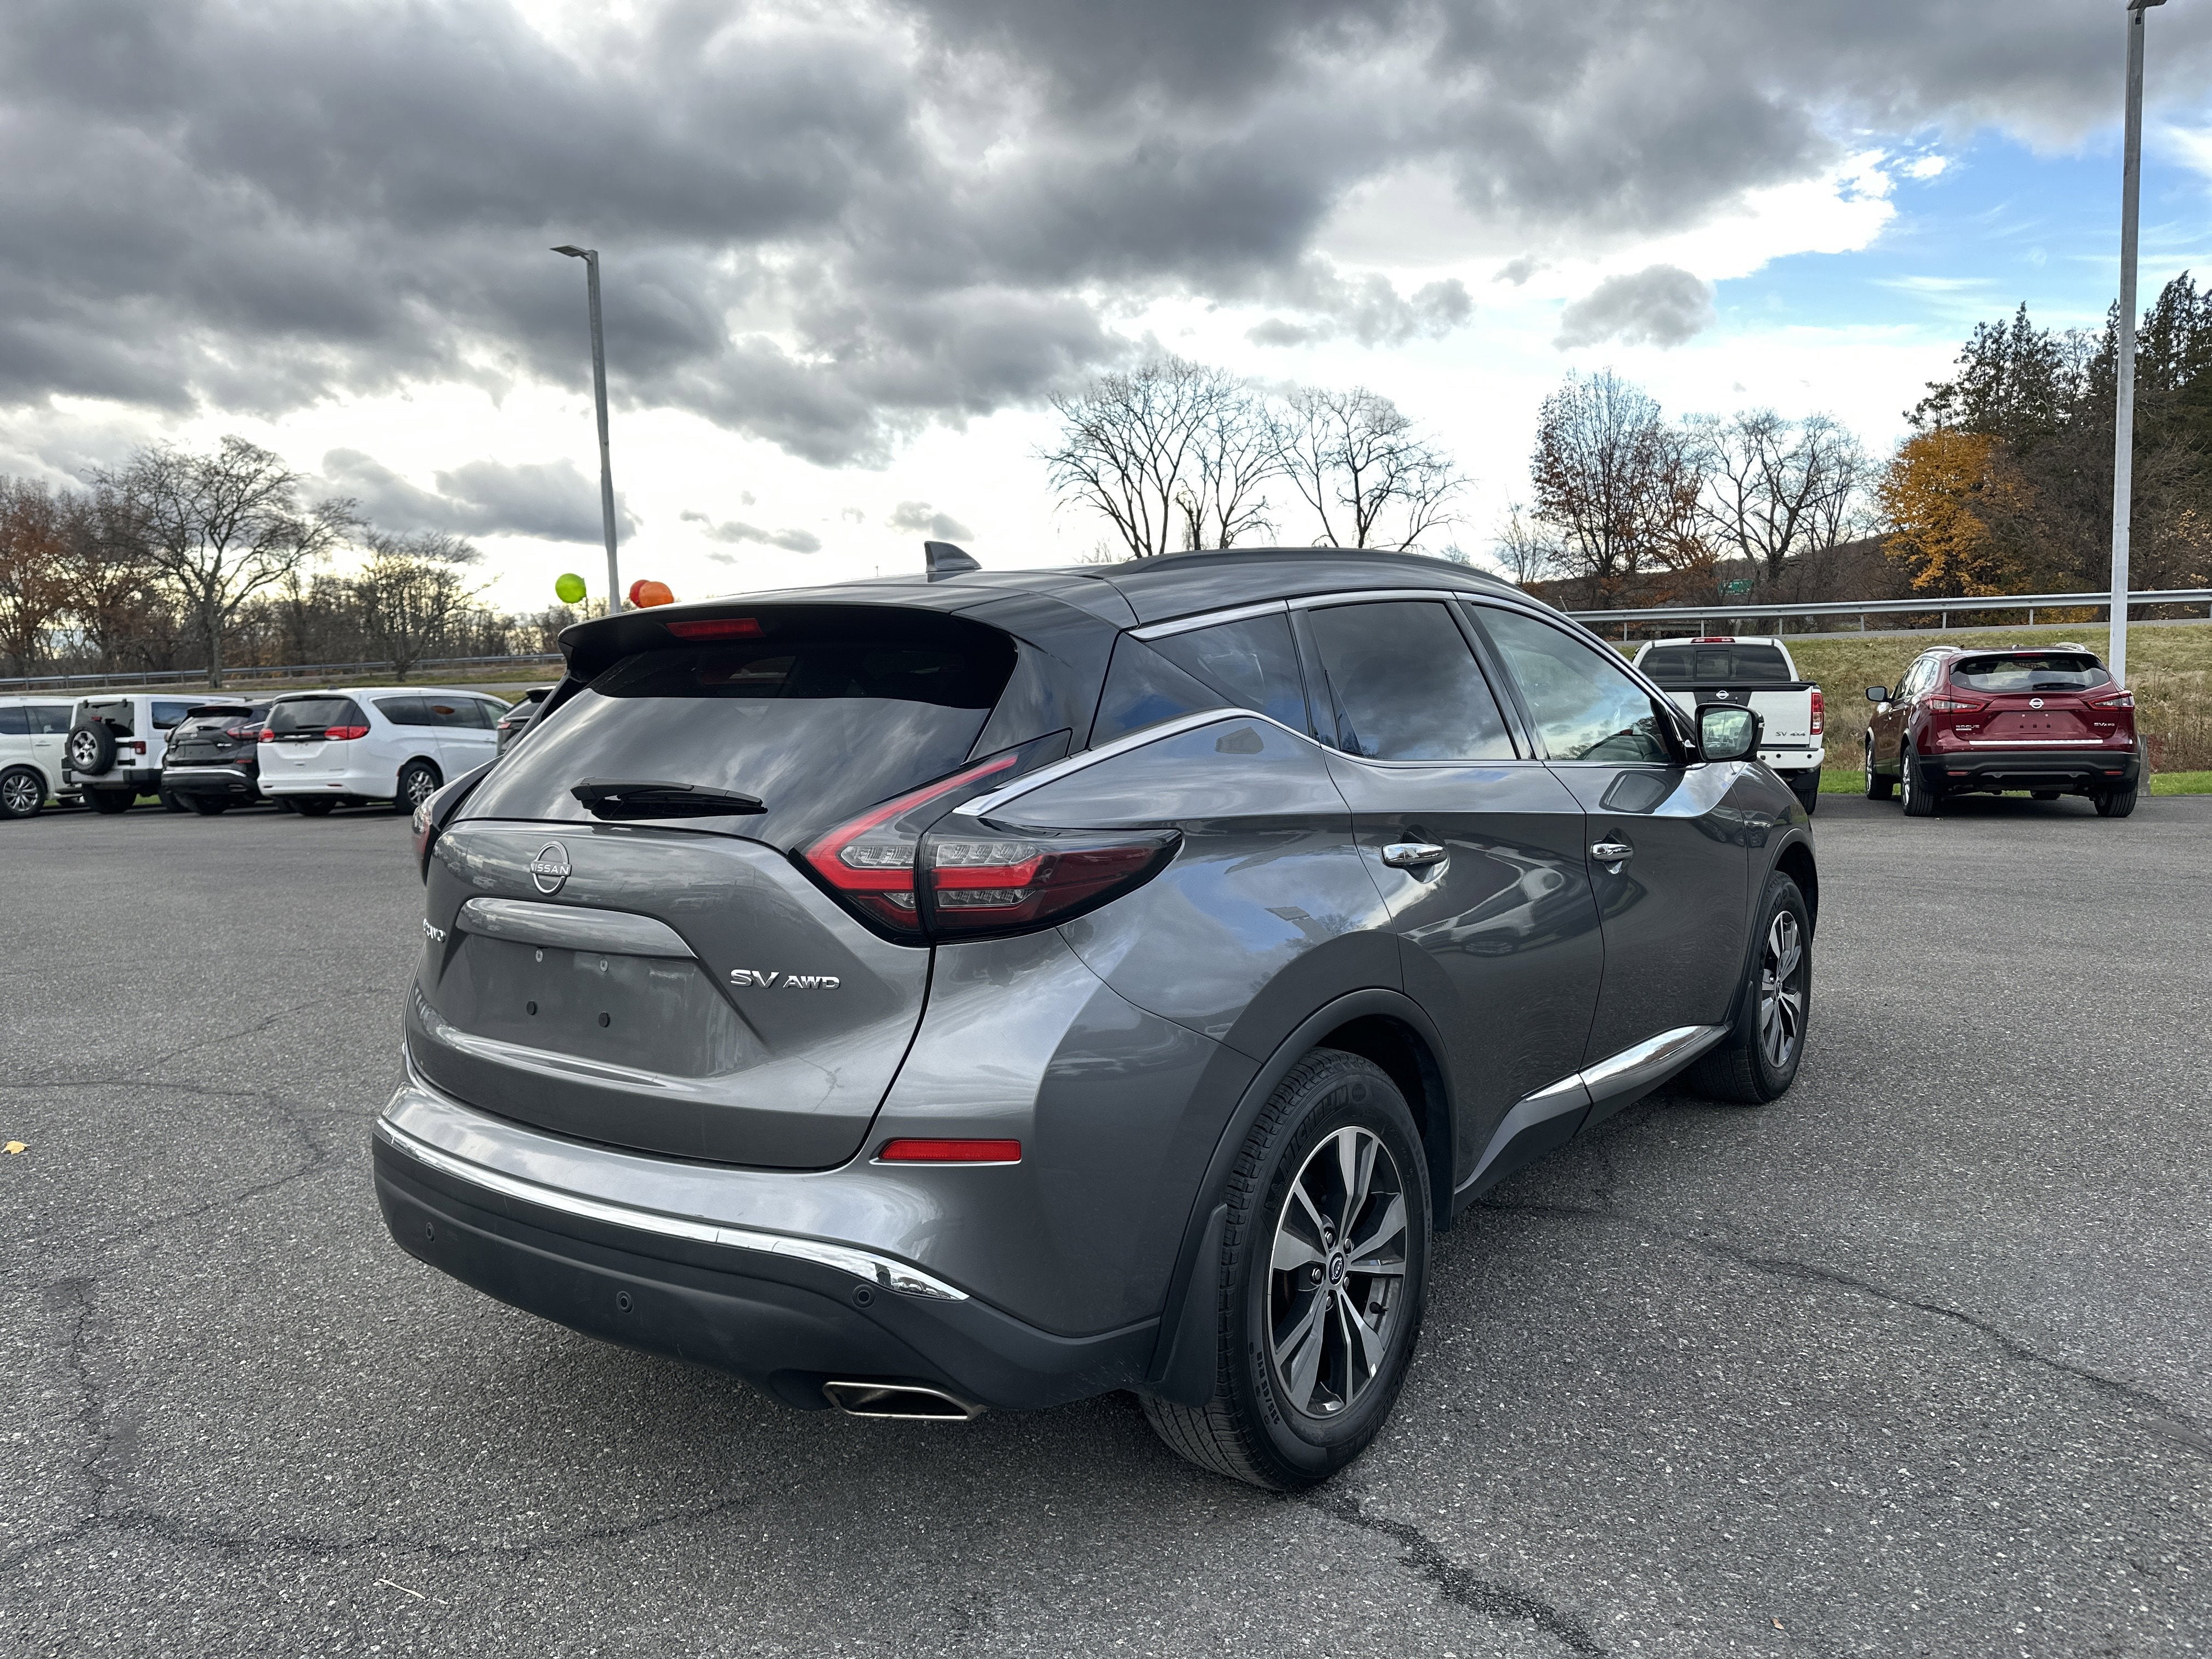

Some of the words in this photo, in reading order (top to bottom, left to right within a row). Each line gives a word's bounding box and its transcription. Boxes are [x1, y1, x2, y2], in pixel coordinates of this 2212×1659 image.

[530, 862, 569, 875] NISSAN
[730, 969, 780, 989] SV
[783, 975, 840, 989] AWD
[1279, 1086, 1348, 1180] MICHELIN
